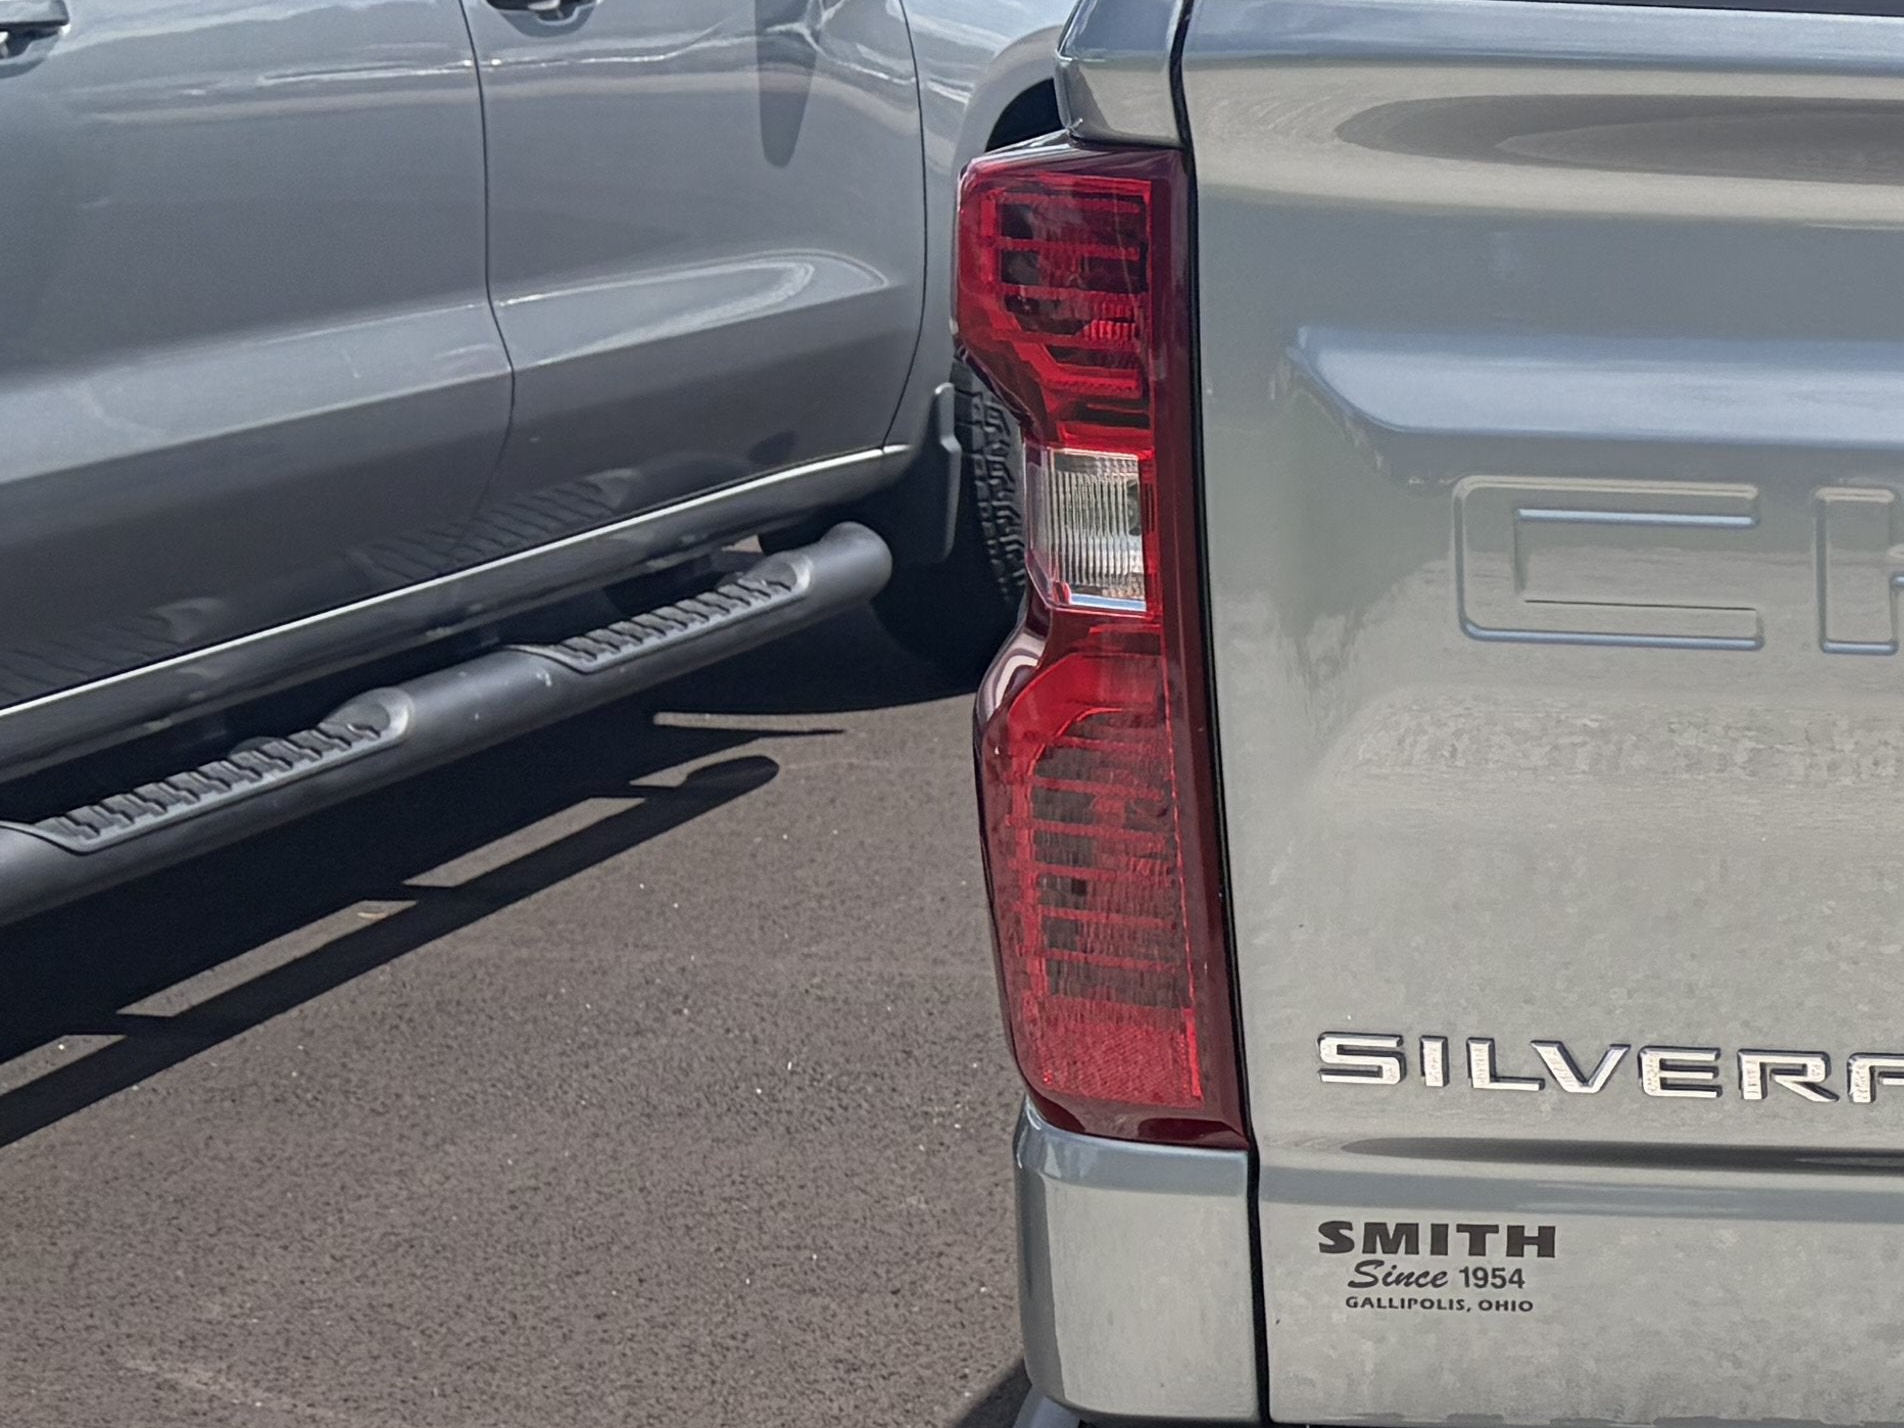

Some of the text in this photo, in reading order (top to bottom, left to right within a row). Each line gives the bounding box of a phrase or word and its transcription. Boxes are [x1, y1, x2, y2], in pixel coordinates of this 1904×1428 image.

[1318, 1220, 1556, 1258] SMITH
[1347, 1259, 1526, 1289] Since 1954
[1345, 1296, 1534, 1313] GALLIPOLIS, OHIO
